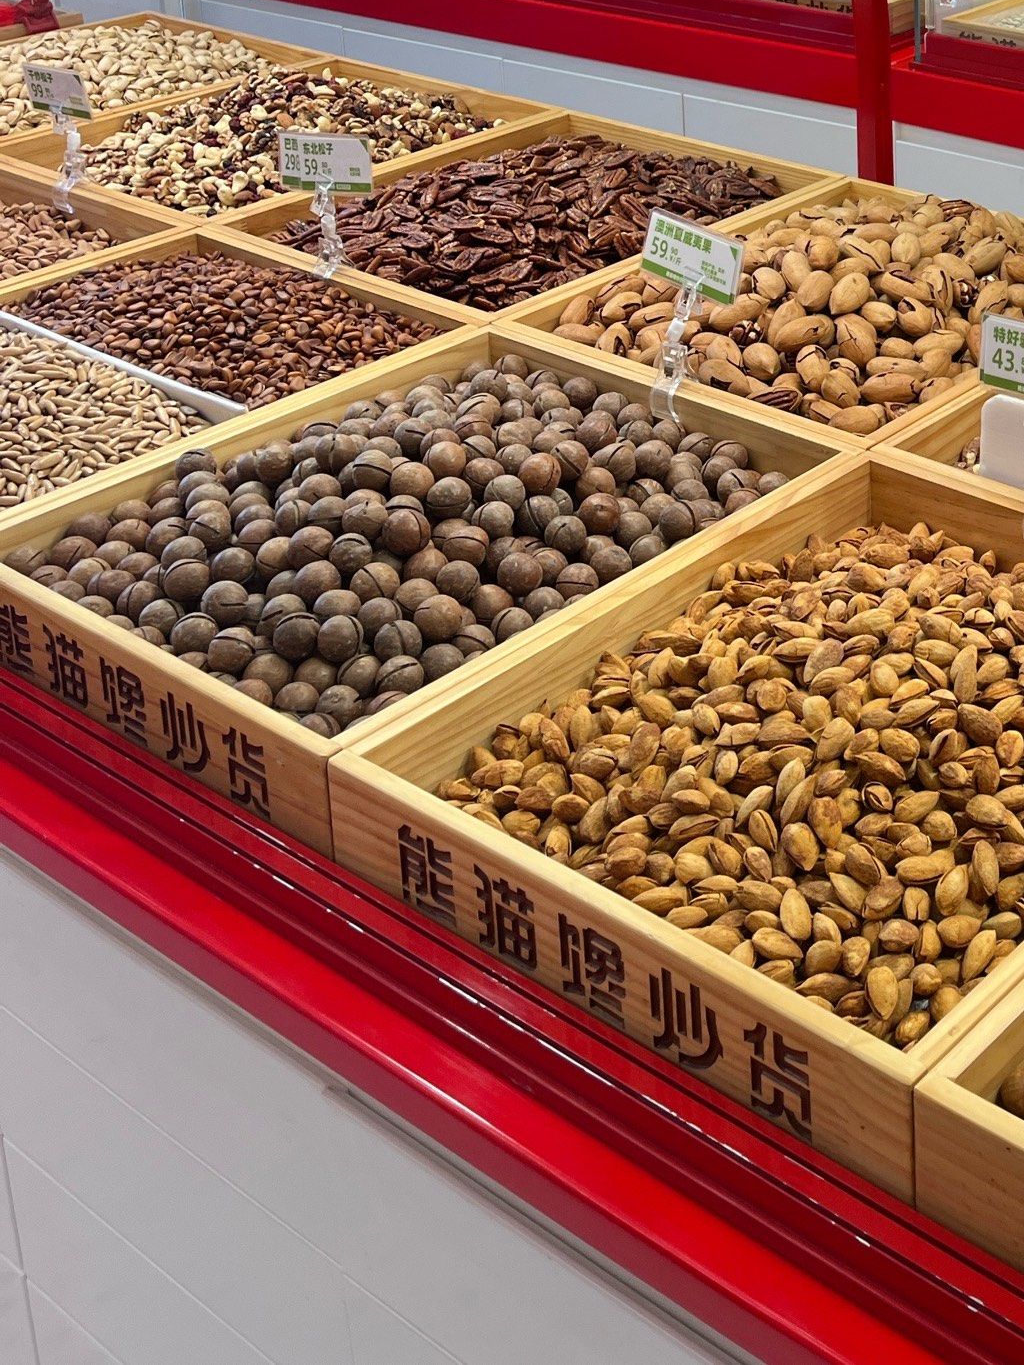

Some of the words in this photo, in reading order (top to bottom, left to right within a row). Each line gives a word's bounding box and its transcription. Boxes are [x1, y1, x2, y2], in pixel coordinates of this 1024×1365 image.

[302, 142, 333, 156] 东北松子
[397, 823, 814, 1143] 熊猫馋炒货
